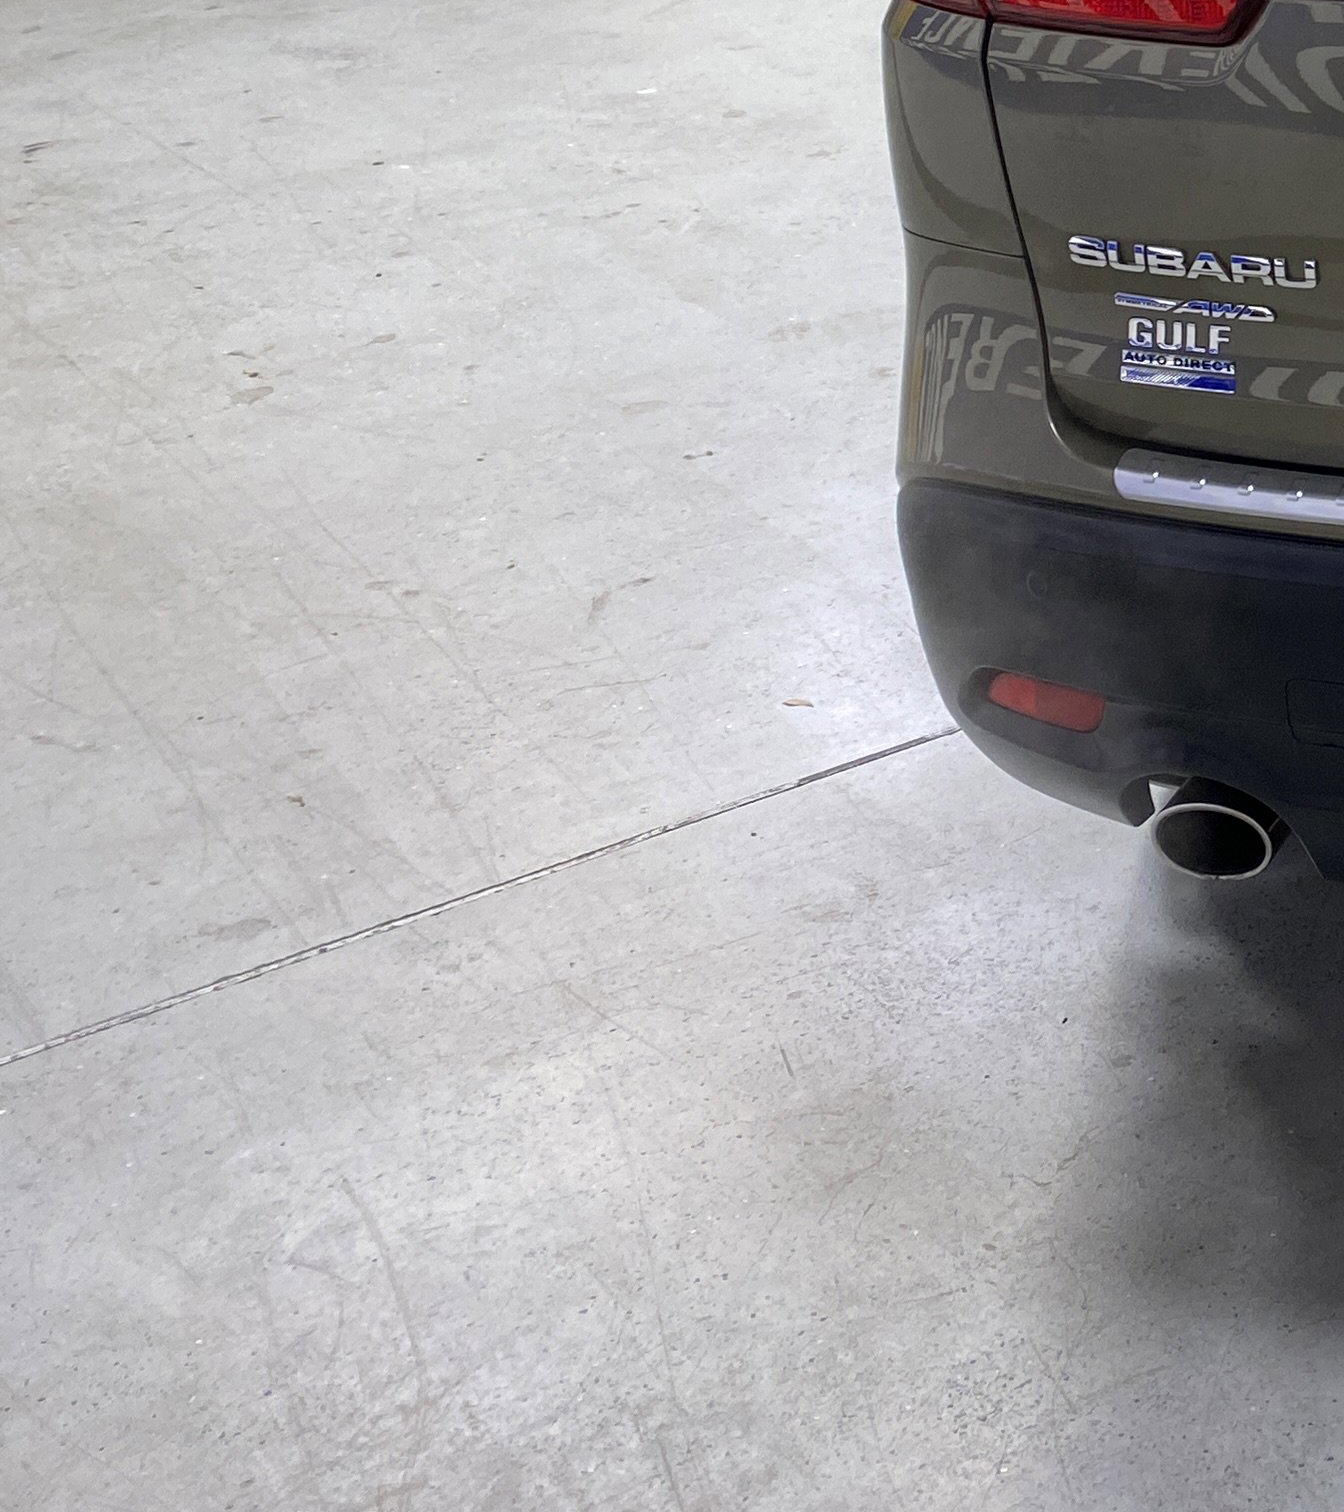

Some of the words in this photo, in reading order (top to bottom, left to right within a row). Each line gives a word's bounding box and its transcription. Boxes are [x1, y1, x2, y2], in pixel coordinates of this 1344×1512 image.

[1067, 234, 1318, 290] SUBARU
[1172, 299, 1276, 323] AWD
[1127, 316, 1232, 355] GULF
[1122, 350, 1168, 366] AUTO
[1172, 356, 1236, 373] DIRECT
